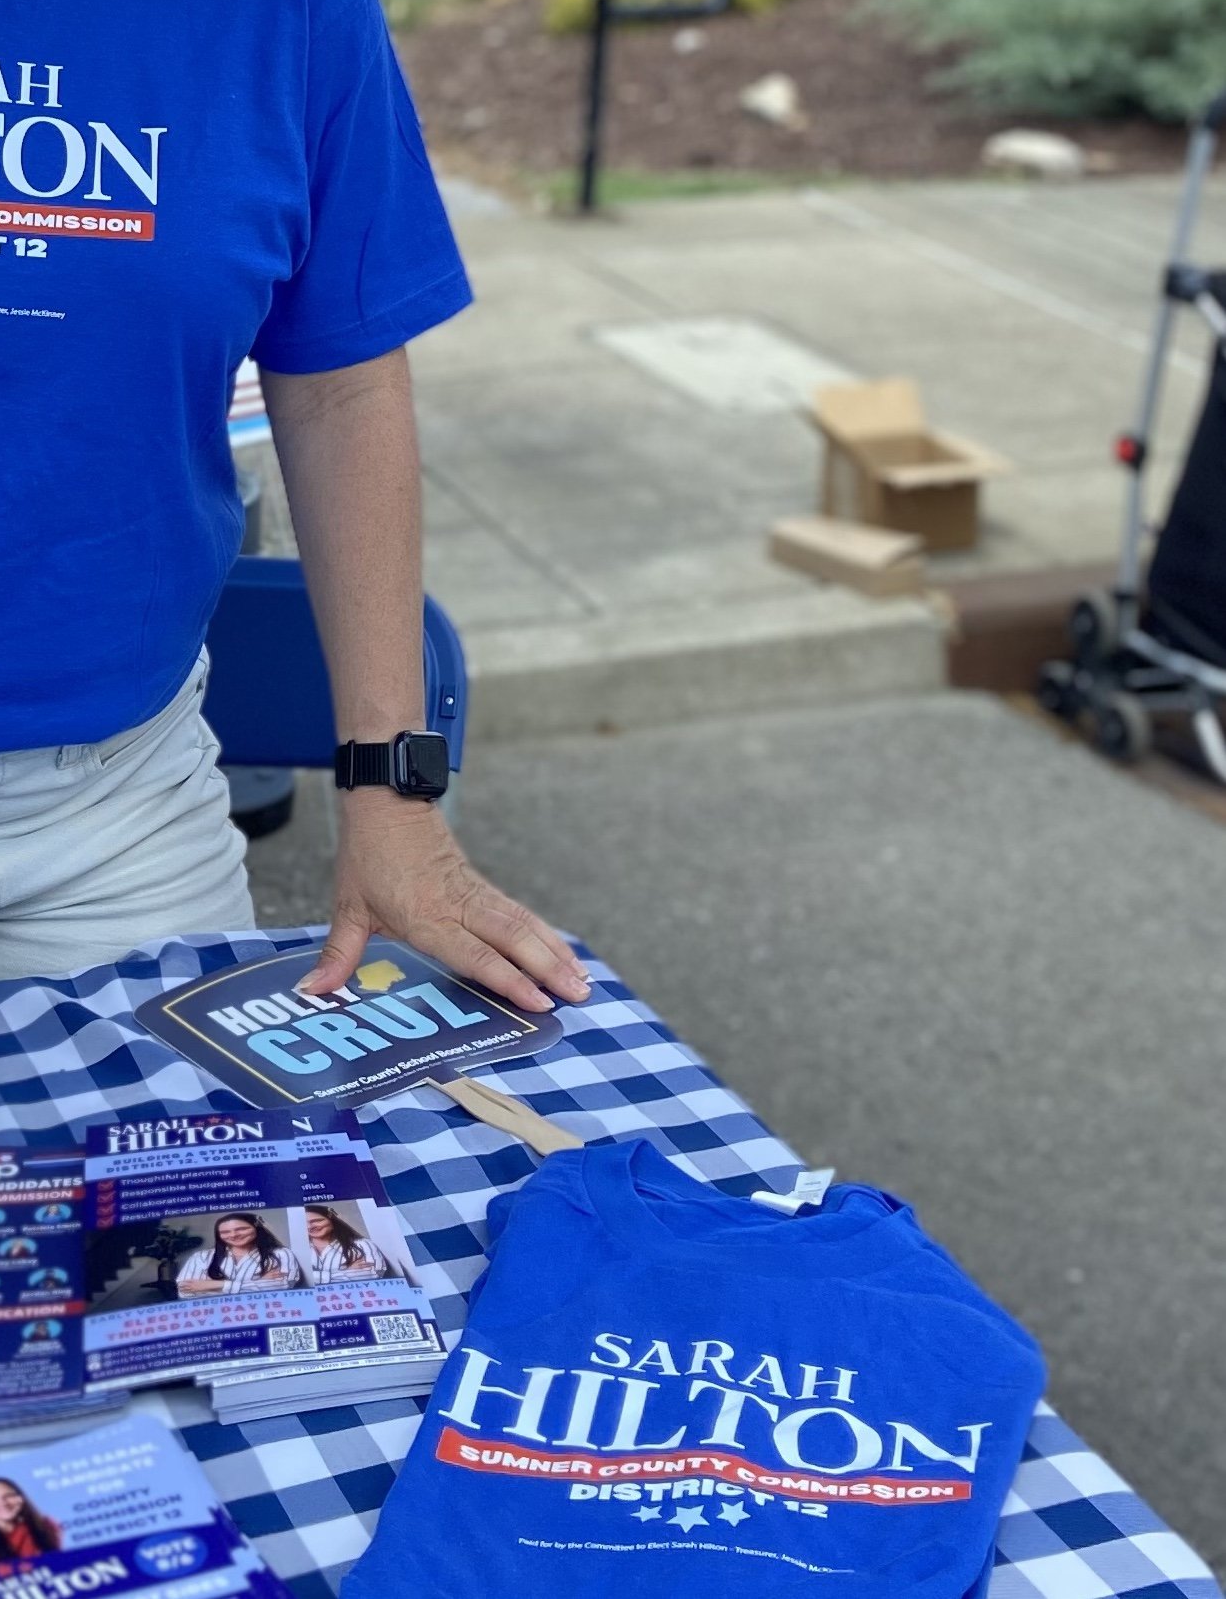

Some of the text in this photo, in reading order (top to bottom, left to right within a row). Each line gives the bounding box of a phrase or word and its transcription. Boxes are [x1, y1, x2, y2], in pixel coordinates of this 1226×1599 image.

[13, 237, 48, 259] 12
[247, 981, 491, 1076] CRUZ
[313, 1079, 360, 1099] Sumner
[358, 1064, 401, 1086] County
[397, 1050, 439, 1070] School
[473, 1033, 513, 1051] District
[107, 1120, 264, 1154] HILTON
[108, 1117, 190, 1136] SARAH
[105, 1158, 174, 1174] DISTRICT
[112, 1145, 276, 1166] BUILDING A STRONGER
[121, 1168, 229, 1186] Thoughtful planning
[121, 1179, 245, 1199] Responsible budgeting
[199, 1192, 217, 1201] not
[219, 1189, 260, 1200] conflict
[164, 1205, 207, 1217] focused
[209, 1200, 266, 1212] leadership
[247, 1292, 279, 1301] JULY
[359, 1289, 378, 1298] IS
[122, 1301, 283, 1328] ELECTION DAY IS
[221, 1313, 260, 1324] AUG
[589, 1332, 860, 1404] SARAH
[438, 1345, 994, 1477] HILTON
[44, 1456, 155, 1491] CANDIDATE
[459, 1443, 955, 1500] SUMNER COUNTY COMMISSION
[87, 1479, 125, 1495] FOR
[569, 1476, 830, 1520] DISTRICT 12
[72, 1487, 151, 1512] COUNTY
[61, 1494, 183, 1529] COMMISSION
[70, 1509, 183, 1543] DISTRICT 12
[139, 1536, 198, 1559] VOTE
[539, 1540, 554, 1549] for
[554, 1541, 566, 1551] by
[567, 1541, 583, 1550] the
[584, 1541, 635, 1552] Committee
[635, 1543, 647, 1551] to
[647, 1541, 670, 1551] Elect
[671, 1540, 698, 1550] Sarah
[699, 1541, 729, 1553] Hilton
